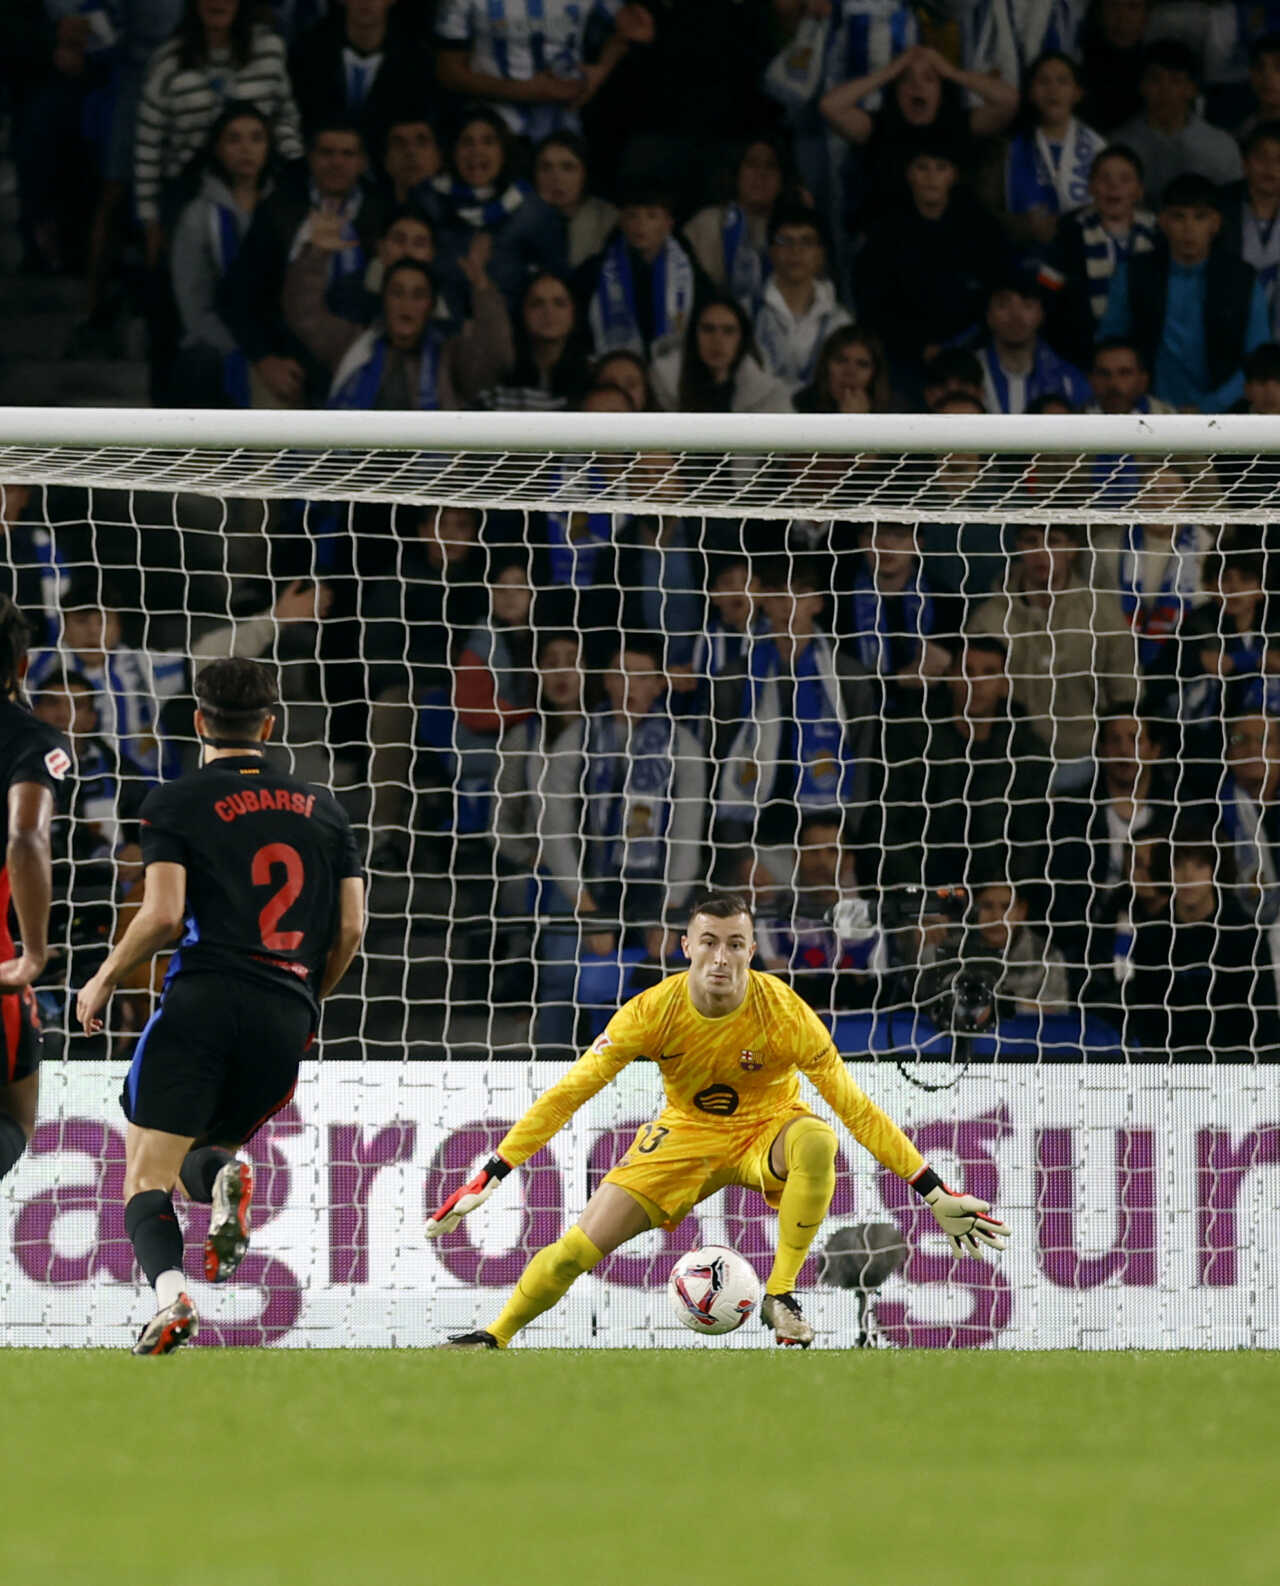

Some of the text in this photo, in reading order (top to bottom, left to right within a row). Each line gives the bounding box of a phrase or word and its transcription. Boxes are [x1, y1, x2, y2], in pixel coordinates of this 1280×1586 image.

[214, 789, 316, 822] CUBARSÍ
[251, 842, 304, 950] 2
[638, 1124, 670, 1154] 13
